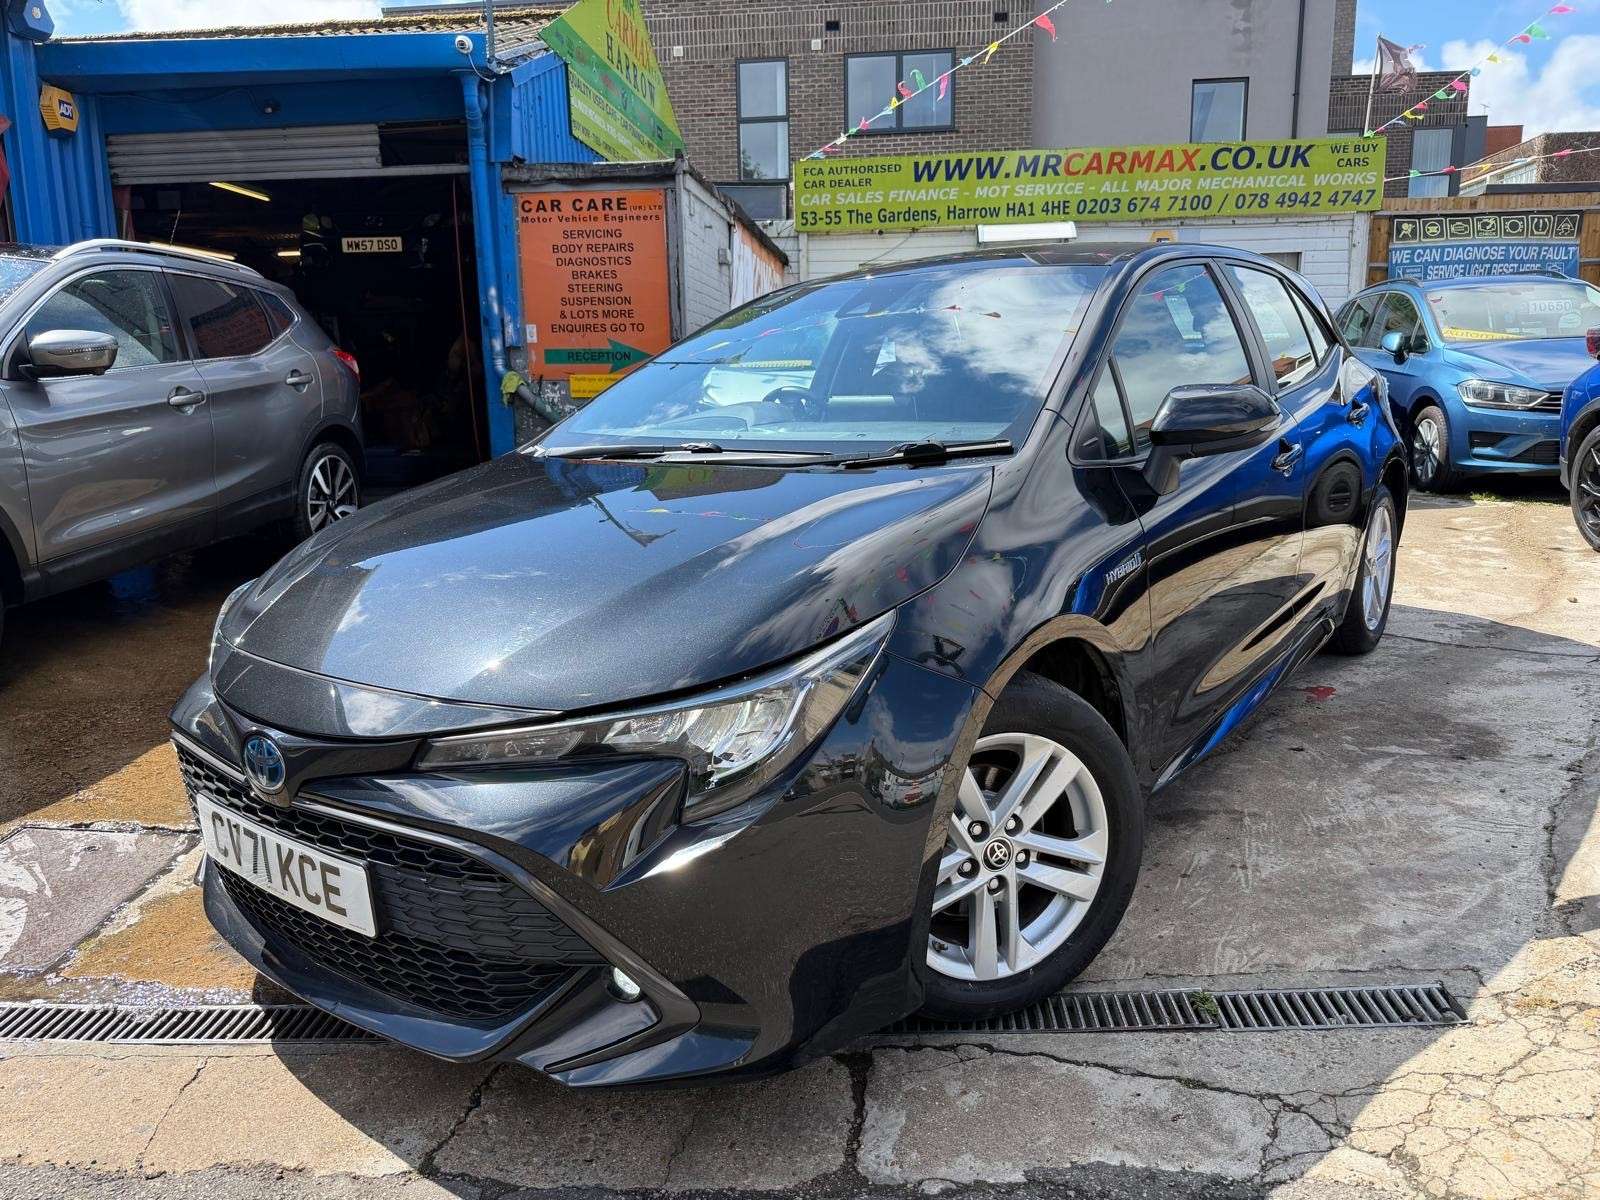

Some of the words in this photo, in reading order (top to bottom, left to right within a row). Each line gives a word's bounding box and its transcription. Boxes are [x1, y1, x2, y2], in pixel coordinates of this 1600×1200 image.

[606, 32, 655, 108] HARROW
[1331, 145, 1351, 154] WE
[1353, 143, 1379, 153] BUY
[913, 144, 1316, 183] WWW.MRCARMAX.CO.UK
[1337, 157, 1369, 168] CARS
[803, 167, 824, 177] FCA
[827, 163, 902, 175] AUTHORISED
[800, 194, 835, 207] CAR
[838, 191, 883, 205] SALES
[888, 188, 958, 203] FINANCE
[975, 185, 1010, 199] MOT
[1014, 181, 1084, 197] SERVICE
[1100, 181, 1129, 193] ALL
[1135, 178, 1192, 191] MAJOR
[1197, 174, 1307, 190] MECHANICAL
[1313, 171, 1377, 185] WORKS
[803, 180, 825, 189] CAR
[829, 178, 872, 188] DEALER
[521, 199, 562, 213] CAR
[572, 197, 627, 211] CARE
[801, 209, 842, 226] 53-55
[847, 207, 873, 225] The
[877, 204, 941, 225] Gardens,
[946, 203, 1001, 221] Harrow
[1006, 201, 1035, 217] HA1
[1041, 200, 1070, 215] 4HE
[1076, 199, 1121, 215] 0203
[1127, 197, 1160, 212] 674
[1167, 195, 1211, 211] 7100
[1235, 193, 1270, 209] 078
[1276, 191, 1321, 208] 4942
[1328, 189, 1376, 206] 4747
[521, 215, 552, 223] Motor
[558, 214, 599, 222] Vehicle
[604, 214, 660, 223] Engineers
[562, 229, 622, 239] SERVICING
[346, 240, 374, 251] MW57
[552, 243, 583, 253] BODY
[586, 242, 634, 252] REPAIRS
[1392, 250, 1411, 264] WE
[1414, 248, 1441, 262] CAN
[1443, 246, 1506, 261] DIAGNOSE
[1509, 246, 1539, 260] YOUR
[1540, 246, 1576, 260] FAULT
[556, 256, 632, 267] DIAGNOSTICS
[572, 270, 618, 280] BRAKES
[1427, 264, 1464, 280] SERVICE
[1466, 263, 1491, 277] LIGHT
[567, 283, 623, 293] STEERING
[561, 296, 632, 306] SUSPENSION
[560, 310, 568, 320] &
[570, 310, 599, 320] LOTS
[602, 309, 634, 319] MORE
[551, 323, 607, 333] ENQUIRES
[610, 323, 627, 333] GO
[630, 322, 645, 332] TO
[567, 351, 631, 361] RECEPTION
[1105, 552, 1142, 585] HYBRID
[211, 811, 273, 883] CV71
[276, 843, 347, 917] KCE
